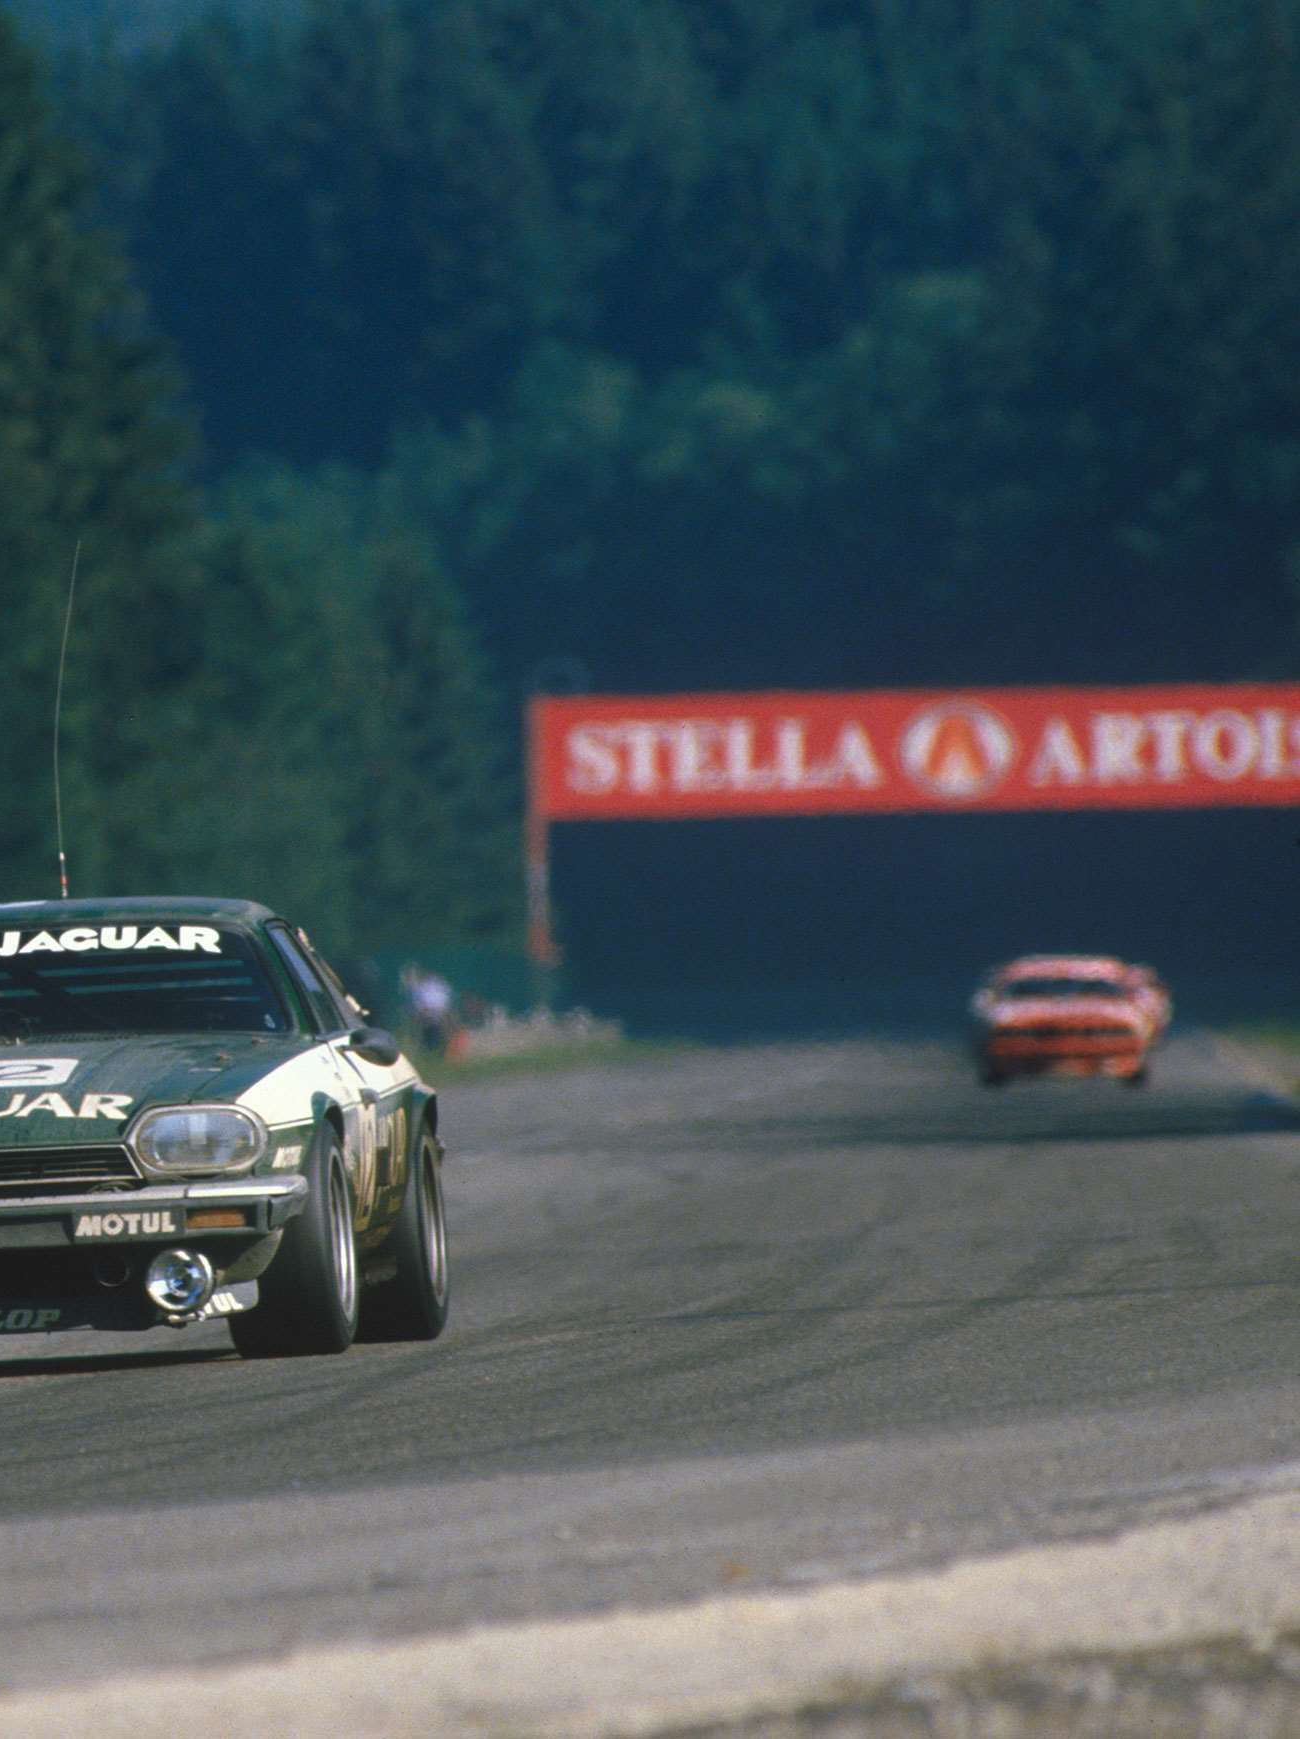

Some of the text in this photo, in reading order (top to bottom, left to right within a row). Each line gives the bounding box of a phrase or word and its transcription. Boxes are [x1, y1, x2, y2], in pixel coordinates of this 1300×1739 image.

[565, 708, 1300, 794] STELLA ARTOI
[75, 1211, 177, 1237] MOTUL
